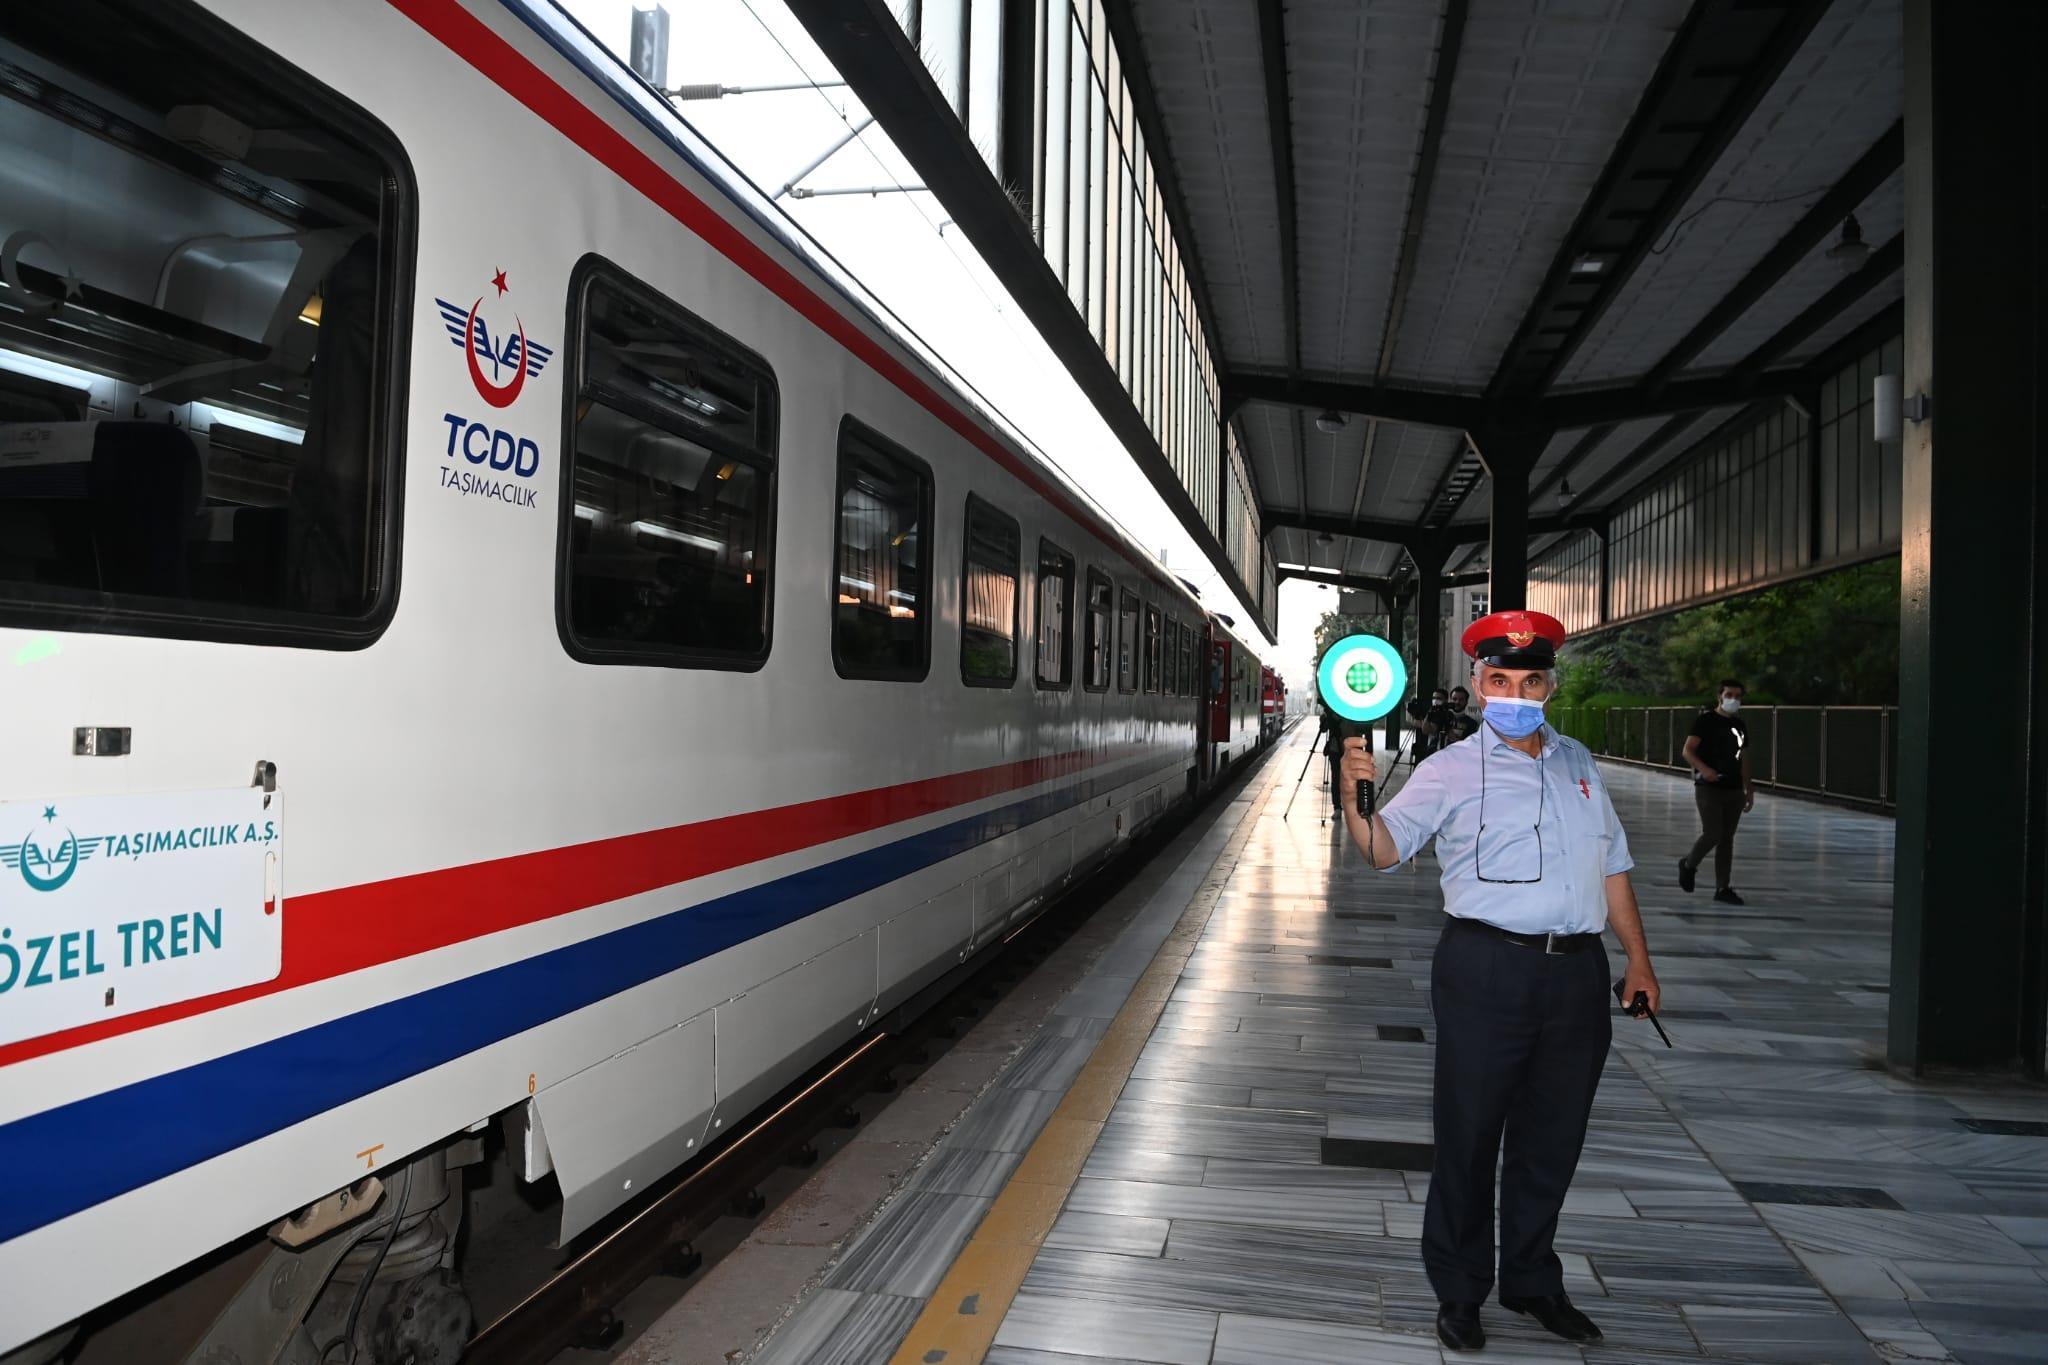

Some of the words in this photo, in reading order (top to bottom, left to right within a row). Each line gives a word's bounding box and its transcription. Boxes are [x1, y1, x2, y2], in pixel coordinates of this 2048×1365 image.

[443, 412, 540, 478] TCDD
[440, 465, 538, 509] TAŞIMACILIK
[105, 824, 239, 861] TAŞIMACILIK
[243, 820, 279, 846] A.Ş.
[117, 908, 222, 968] TREN
[528, 1073, 536, 1094] 6
